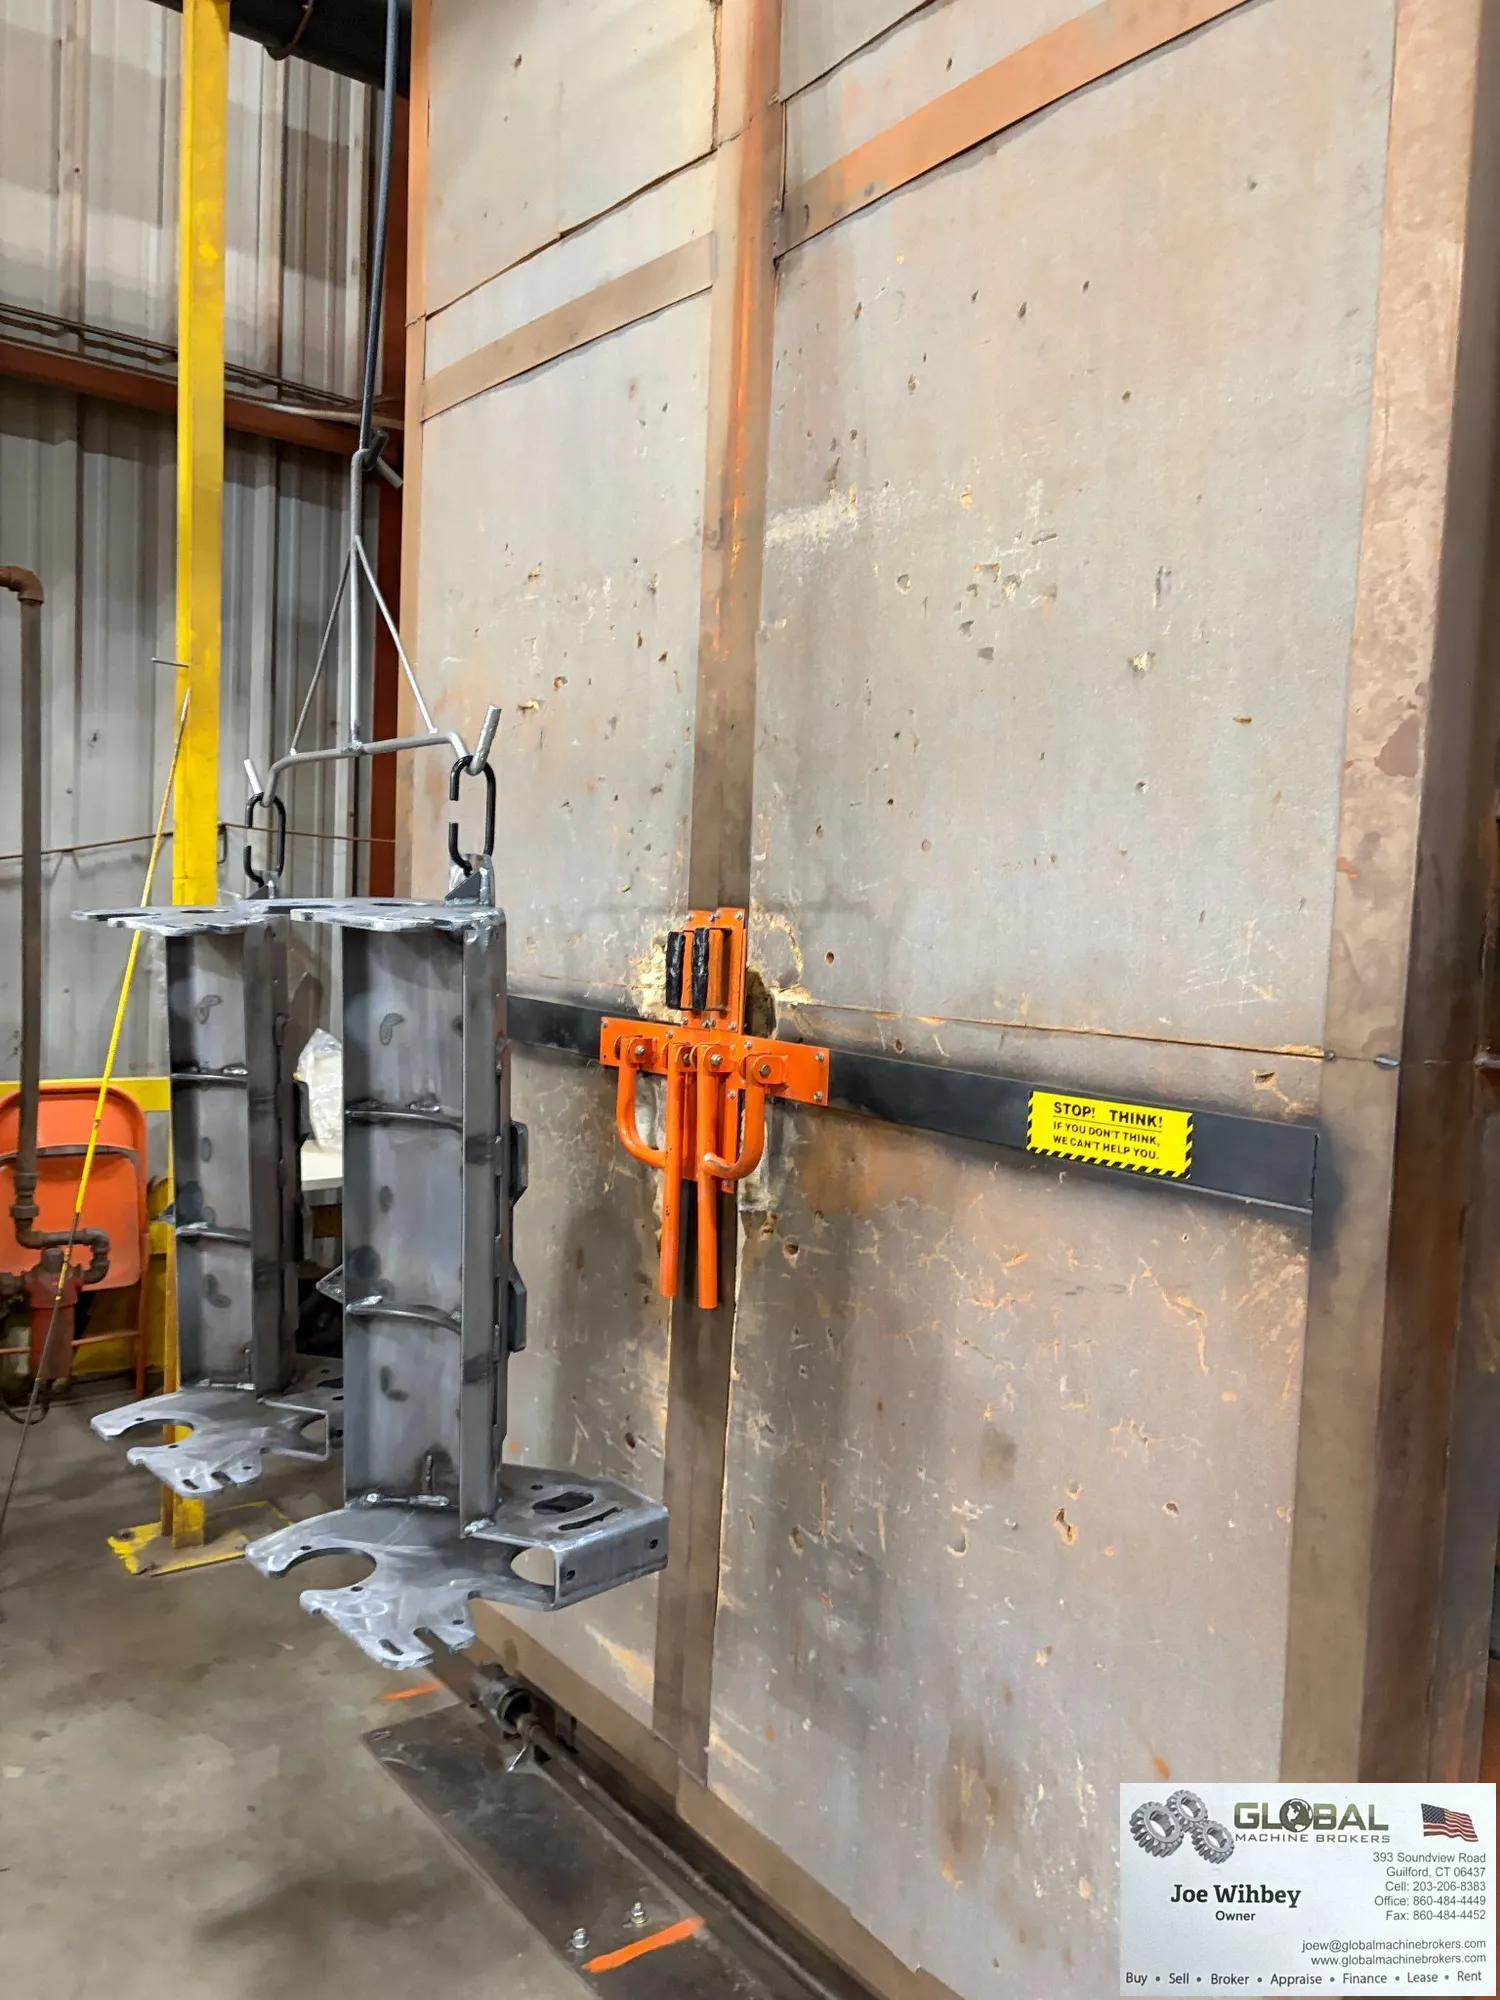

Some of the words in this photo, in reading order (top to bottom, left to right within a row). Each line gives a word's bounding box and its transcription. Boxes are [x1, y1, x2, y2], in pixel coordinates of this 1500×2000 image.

[1054, 1101, 1096, 1119] STOP!
[1109, 1109, 1163, 1128] THINK!
[1053, 1121, 1062, 1130] IF
[1065, 1122, 1086, 1134] YOU
[1088, 1126, 1121, 1139] DON'T
[1053, 1135, 1068, 1145] WE
[1070, 1137, 1100, 1150] CAN'T
[1102, 1144, 1131, 1155] HELP
